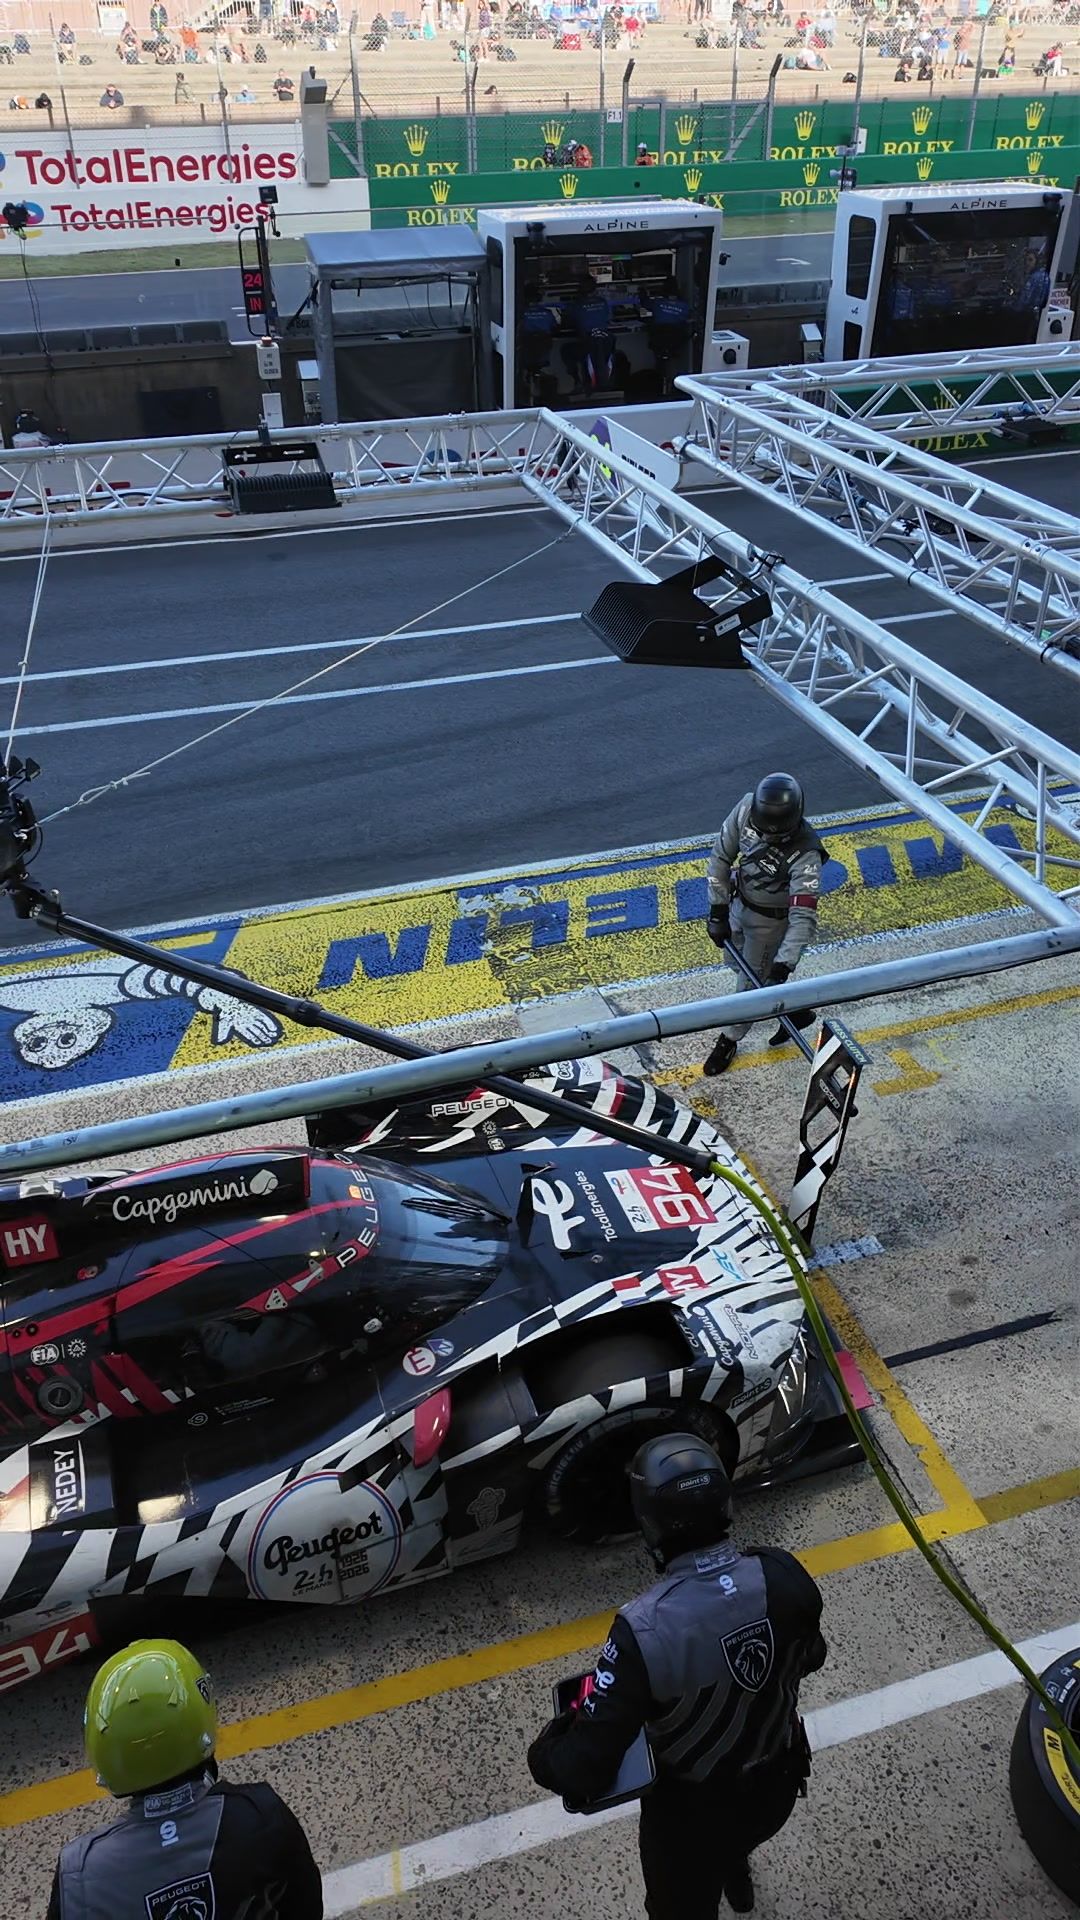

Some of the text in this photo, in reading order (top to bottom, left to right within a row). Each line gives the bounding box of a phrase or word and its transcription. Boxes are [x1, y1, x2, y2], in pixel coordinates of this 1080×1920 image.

[15, 144, 297, 185] TotalEnergies
[780, 188, 840, 207] ROLEX
[949, 199, 1008, 210] ALPINE
[51, 196, 269, 233] TotalEnergies
[407, 207, 476, 226] ROLEX
[583, 220, 649, 232] ALPINE
[244, 272, 263, 288] 24
[250, 297, 262, 311] IN
[433, 1097, 516, 1115] PEUGEO
[112, 1175, 249, 1224] Capgemini
[574, 1169, 618, 1243] TotalEnergies
[4, 1224, 47, 1258] HY
[698, 1314, 735, 1367] Capgemini
[33, 1347, 57, 1362] FIA
[53, 1449, 78, 1514] NEDEY
[264, 1510, 382, 1577] Peugeot
[725, 1624, 767, 1648] PEUGEOT
[152, 1880, 208, 1907] PEUGEOT
